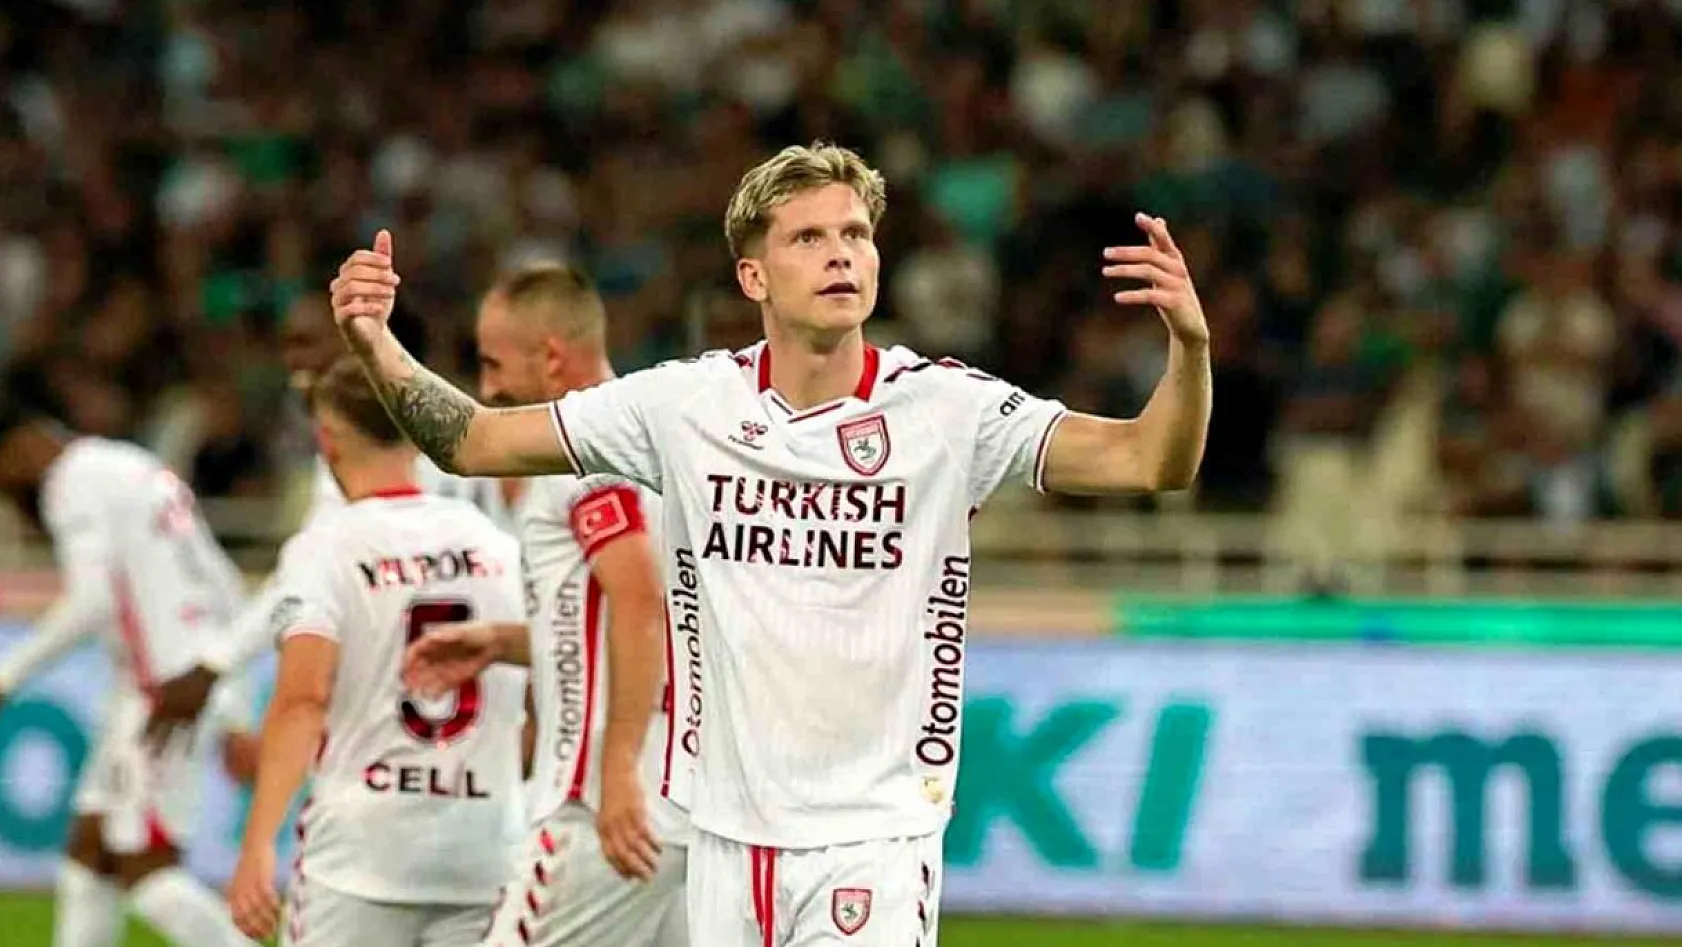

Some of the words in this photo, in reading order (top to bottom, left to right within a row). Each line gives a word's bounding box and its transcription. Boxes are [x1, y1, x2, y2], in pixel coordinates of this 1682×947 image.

[701, 521, 904, 570] AIRLINES
[706, 474, 906, 523] TURKISH
[398, 598, 484, 744] 5
[671, 547, 704, 758] Otomobilen
[915, 555, 970, 766] Otomobilen
